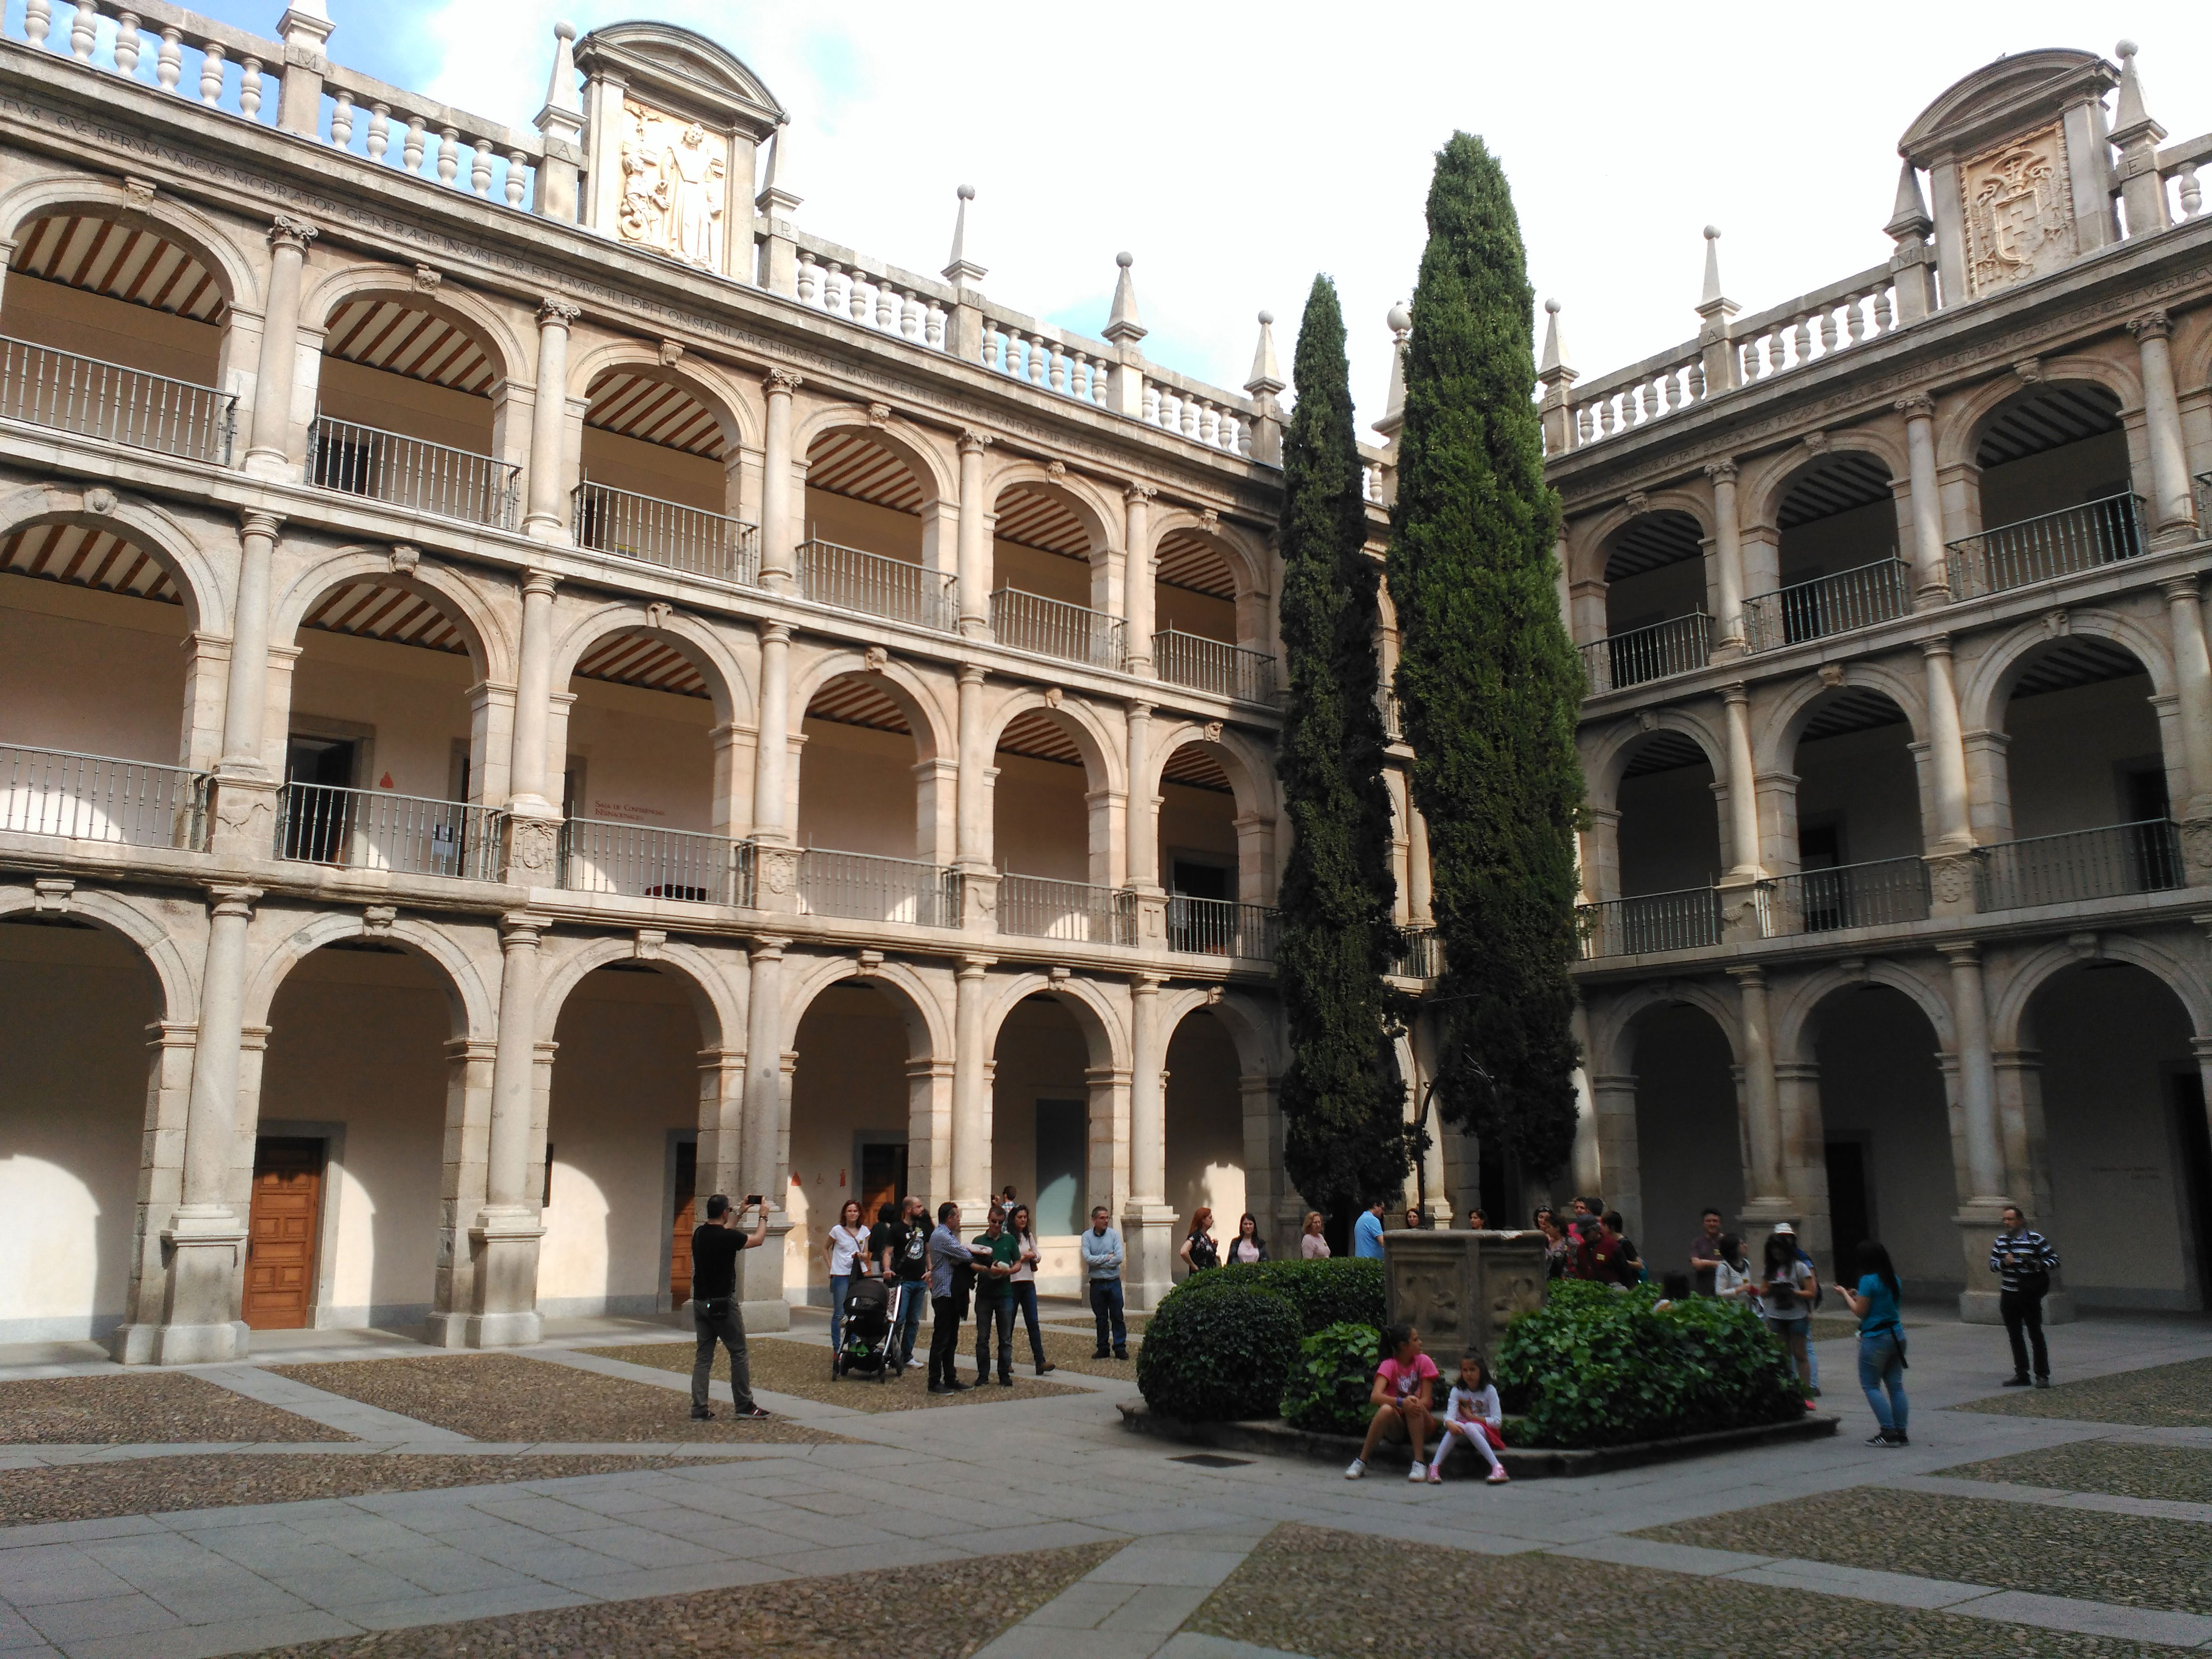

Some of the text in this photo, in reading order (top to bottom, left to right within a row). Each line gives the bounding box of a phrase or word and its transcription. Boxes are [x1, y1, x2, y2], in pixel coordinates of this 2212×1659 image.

[298, 48, 317, 70] M
[556, 144, 572, 160] A
[780, 220, 792, 238] R
[967, 290, 980, 307] M
[1270, 405, 1278, 418] R
[532, 266, 556, 281] ET
[1546, 394, 1557, 408] E
[1706, 330, 1718, 343] A
[2127, 158, 2142, 175] E
